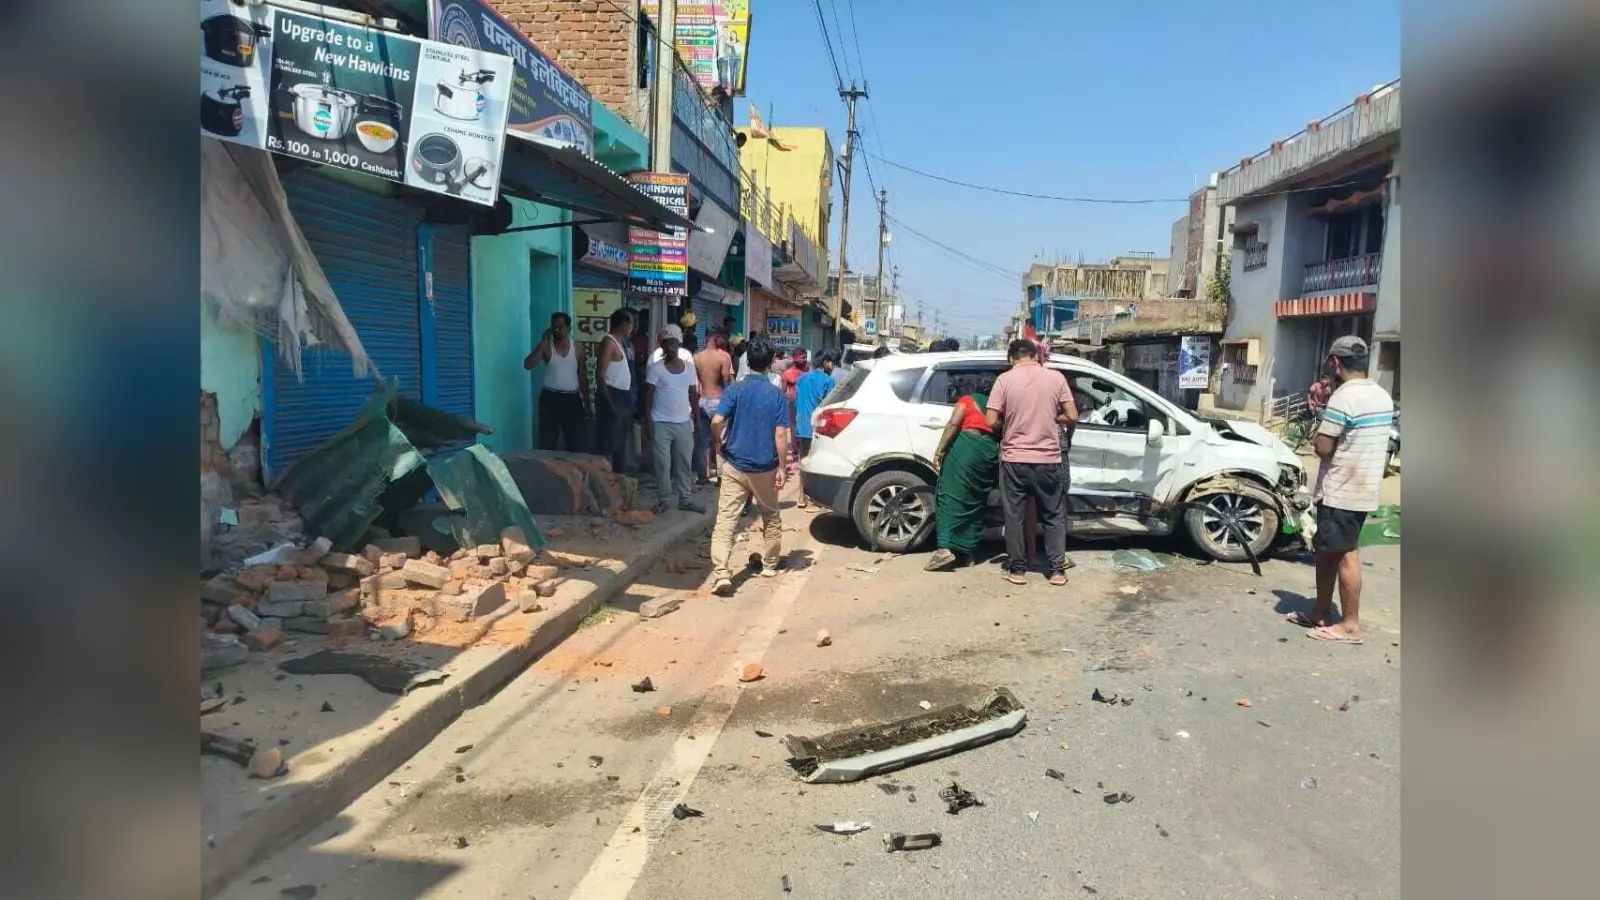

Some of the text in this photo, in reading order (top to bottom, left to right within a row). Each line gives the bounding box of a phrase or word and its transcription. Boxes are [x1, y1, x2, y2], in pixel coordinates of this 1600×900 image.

[282, 18, 374, 52] Upgrade to a
[425, 47, 471, 62] STAINLESS STEEL
[425, 53, 452, 63] CONTURA
[314, 46, 410, 81] New Hawkins
[443, 126, 467, 136] CERAMIC
[268, 135, 285, 150] Rs.
[287, 140, 311, 156] 100
[312, 149, 321, 158] to
[324, 149, 359, 167] 1,000
[639, 184, 685, 196] HANDWA
